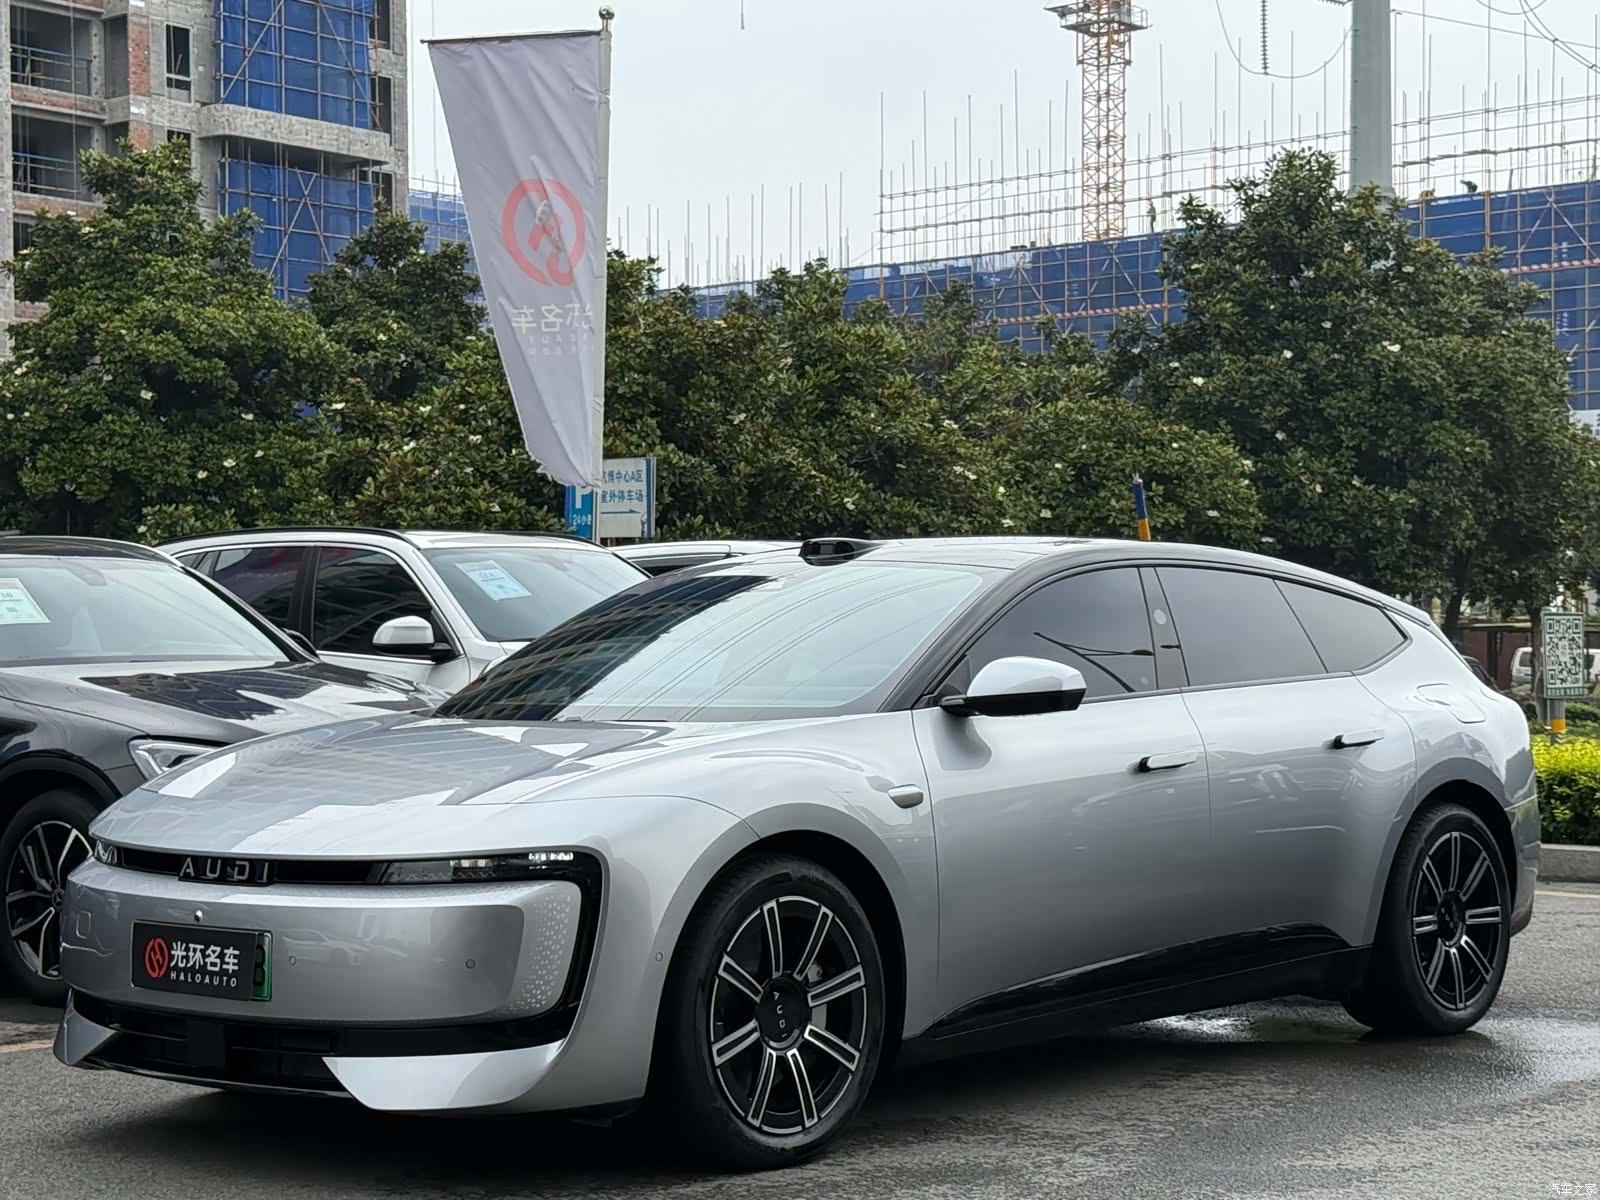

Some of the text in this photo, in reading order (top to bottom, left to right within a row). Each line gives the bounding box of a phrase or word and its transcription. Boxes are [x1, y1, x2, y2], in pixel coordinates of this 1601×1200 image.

[601, 489, 644, 504] 室外停车场
[179, 857, 270, 883] AUDI
[170, 941, 240, 974] 光环名车
[170, 970, 238, 988] HALOAUTO
[772, 991, 788, 1039] AUDI
